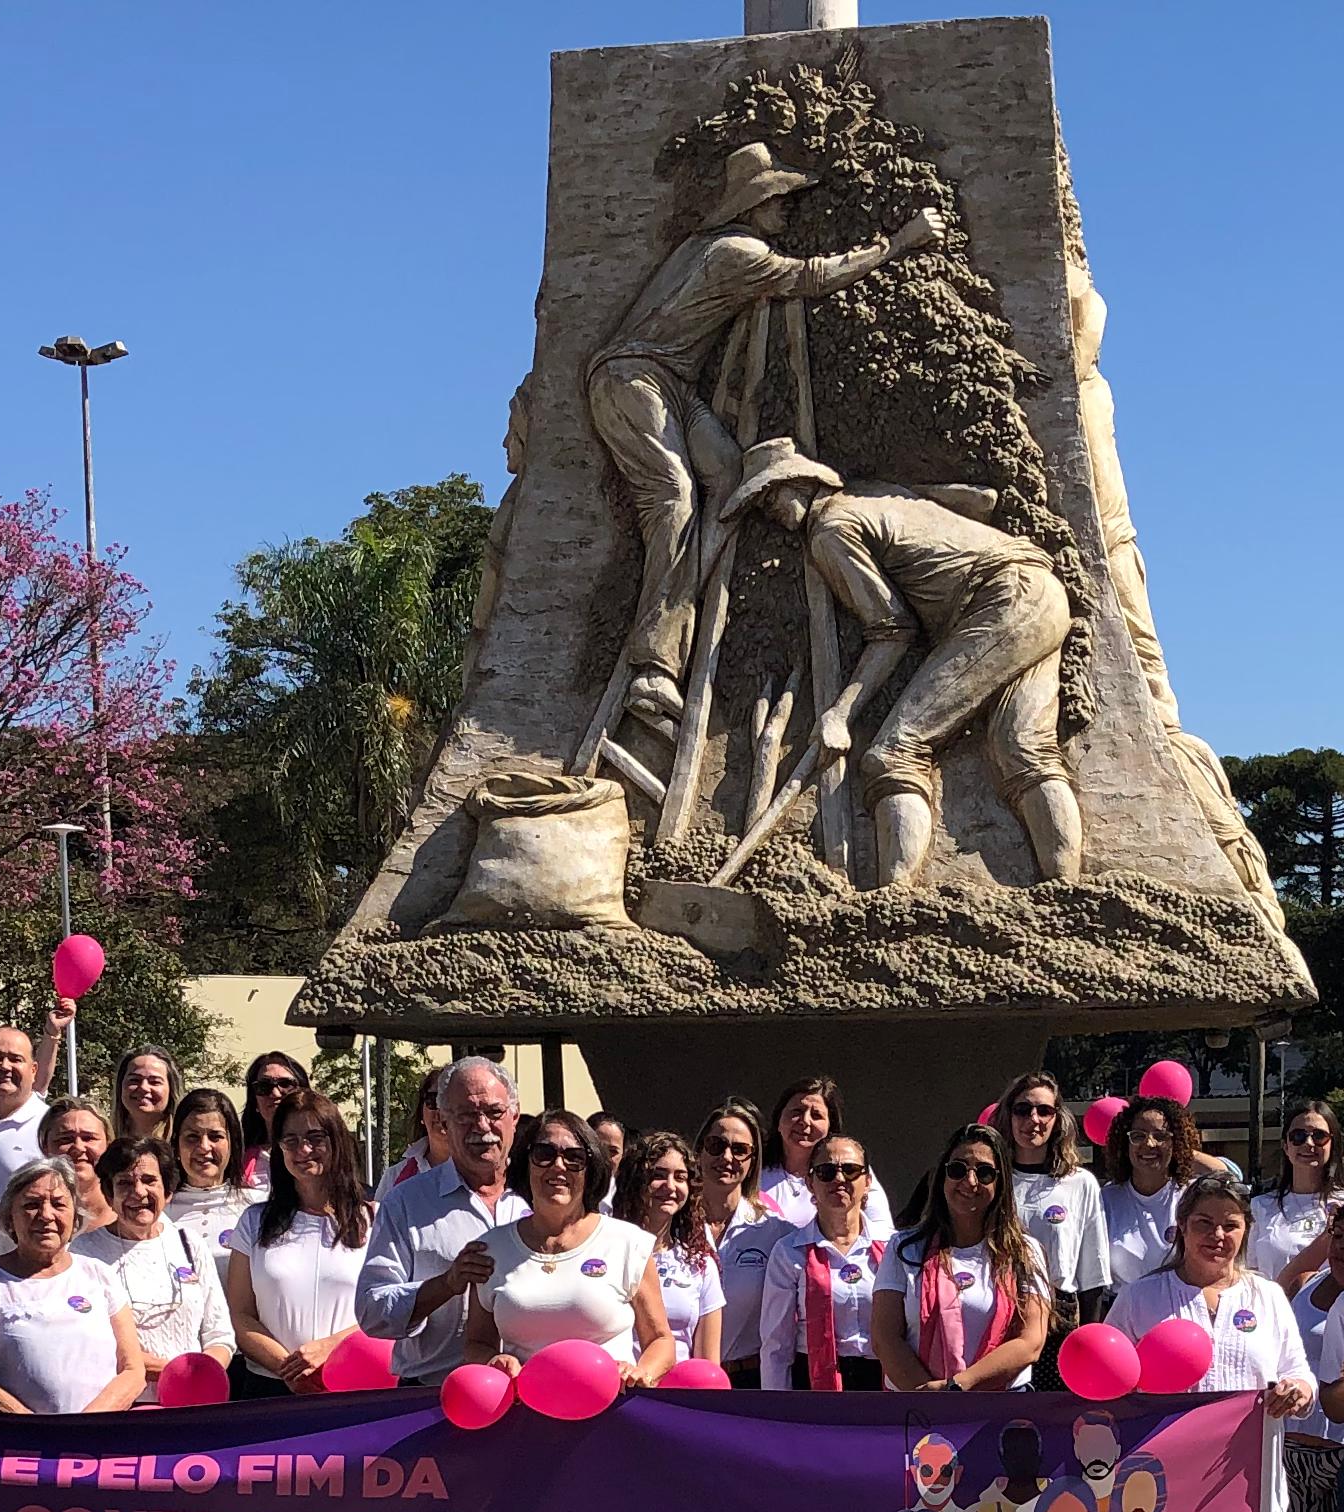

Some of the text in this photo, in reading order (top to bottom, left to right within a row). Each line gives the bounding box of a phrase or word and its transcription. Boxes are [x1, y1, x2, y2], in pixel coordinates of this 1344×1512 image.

[0, 1450, 41, 1487] E
[56, 1453, 221, 1494] PELO
[237, 1454, 345, 1498] FIM
[362, 1455, 449, 1500] DA
